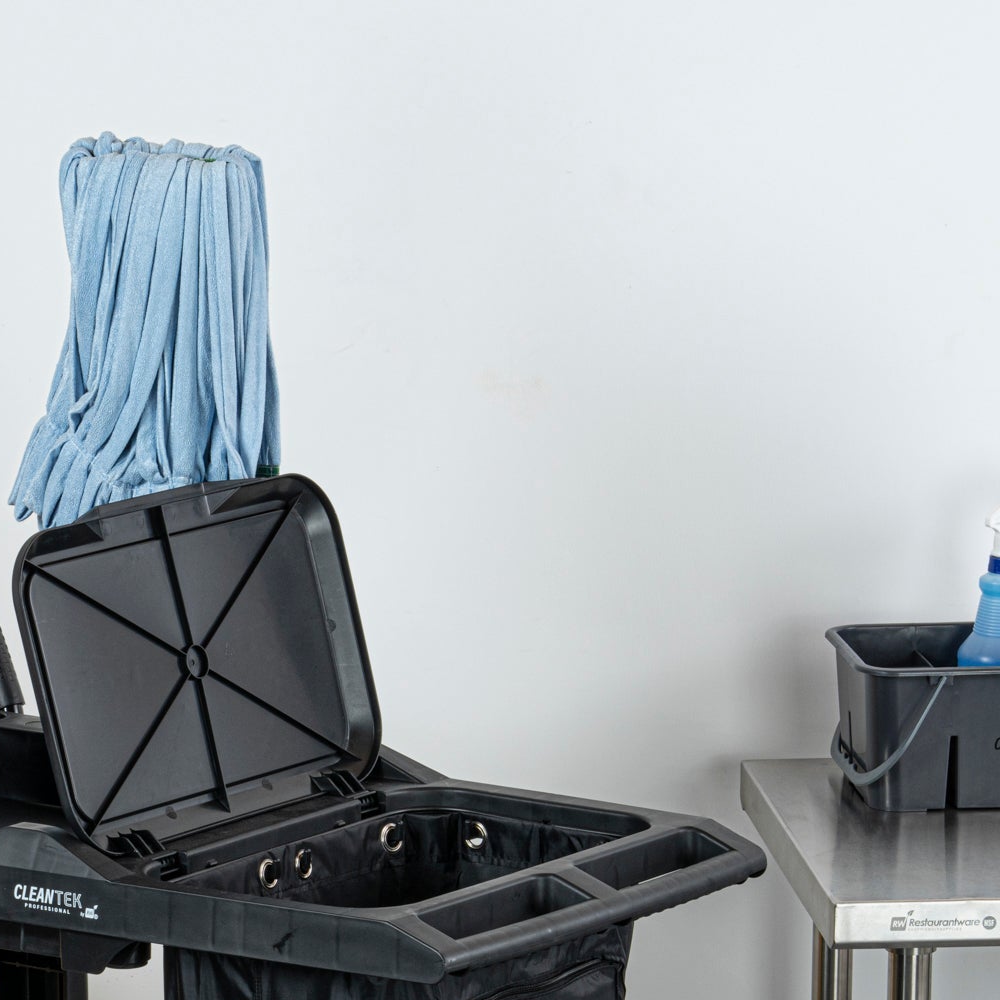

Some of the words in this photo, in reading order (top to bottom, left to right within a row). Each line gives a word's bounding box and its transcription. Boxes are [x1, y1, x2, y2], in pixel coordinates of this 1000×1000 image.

[14, 884, 82, 908] CLEANTEK
[24, 902, 70, 914] PROFESSIONAL
[909, 918, 980, 926] Restaurantware
